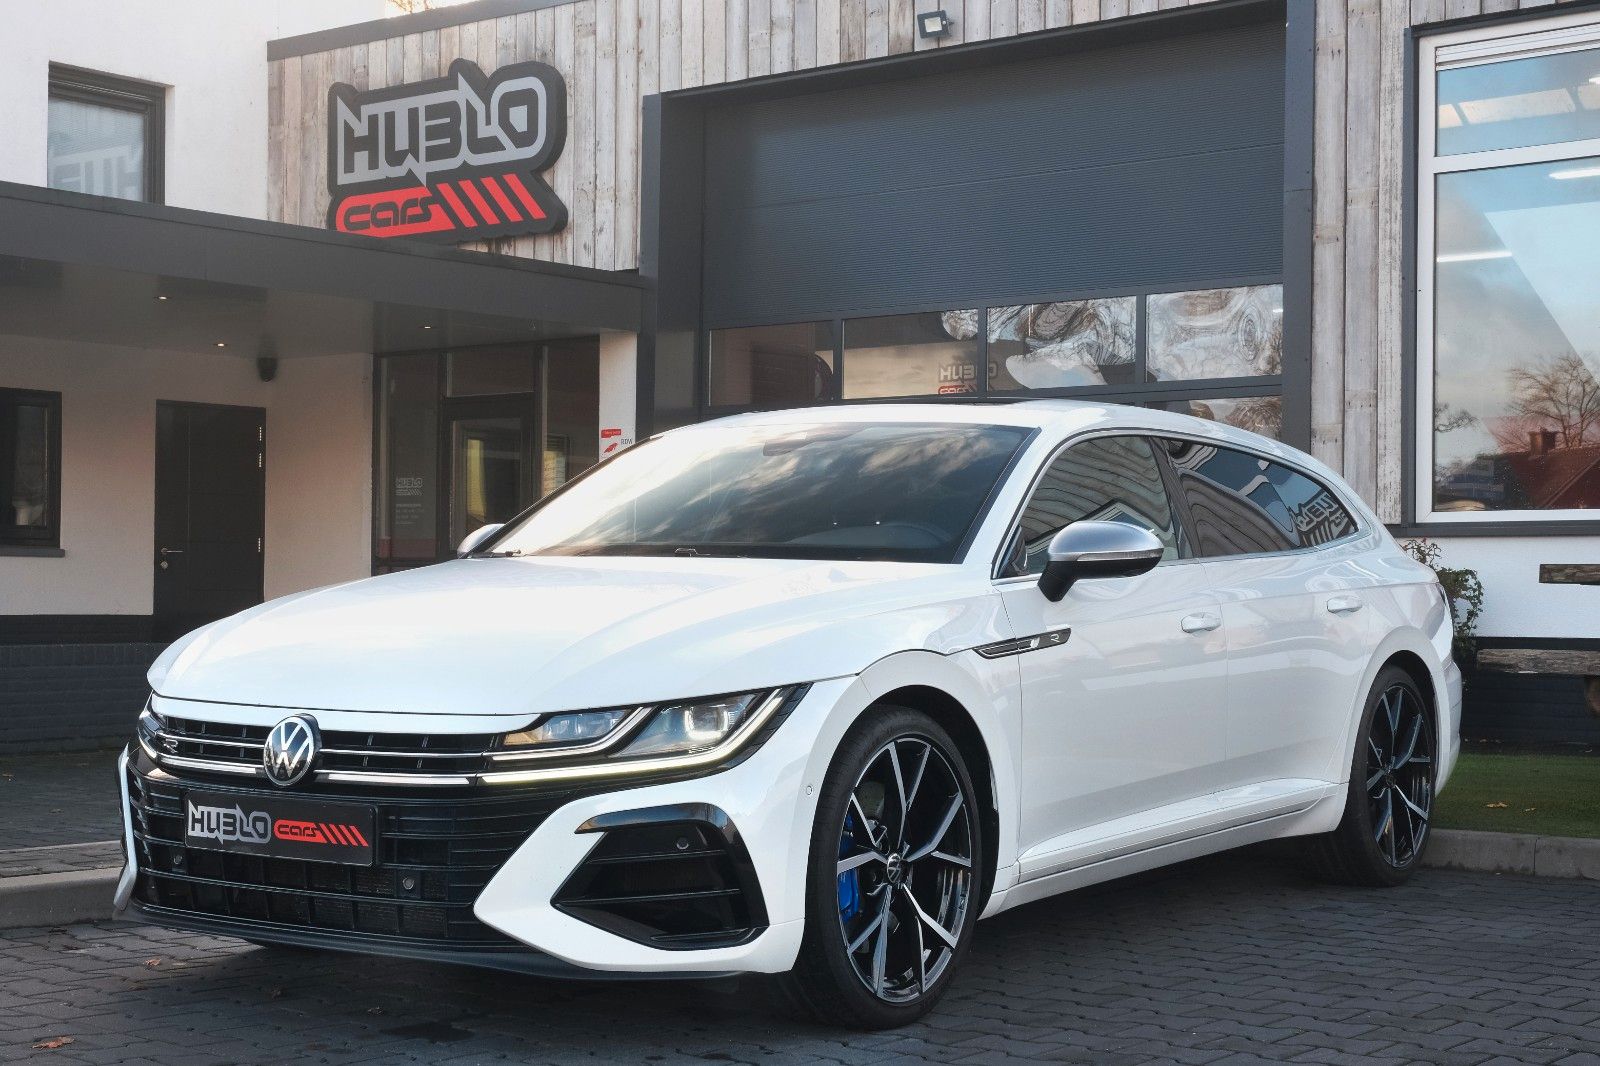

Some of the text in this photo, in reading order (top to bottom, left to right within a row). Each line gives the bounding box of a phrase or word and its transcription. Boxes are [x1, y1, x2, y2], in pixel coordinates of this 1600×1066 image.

[337, 72, 547, 187] HUBLO
[341, 195, 435, 232] cars
[187, 799, 319, 845] HUBLO cars
